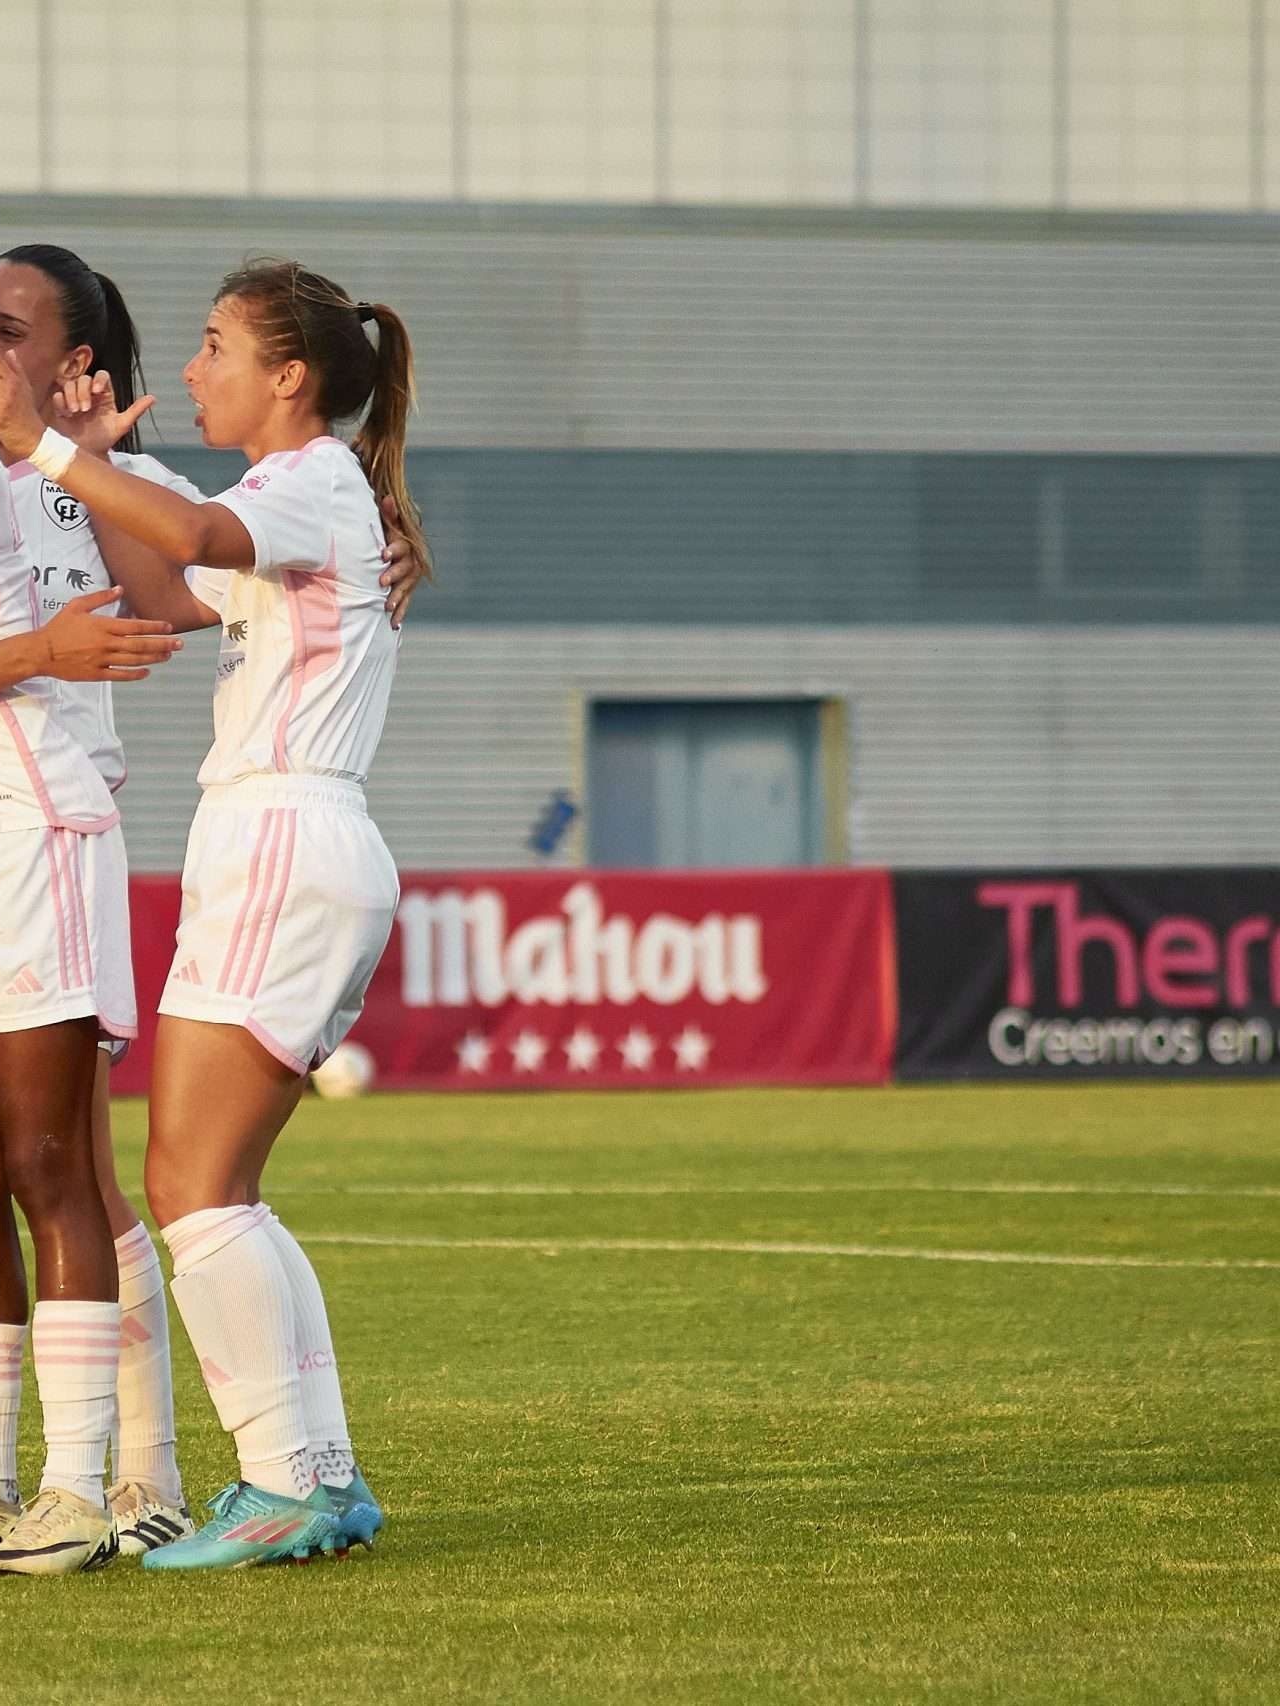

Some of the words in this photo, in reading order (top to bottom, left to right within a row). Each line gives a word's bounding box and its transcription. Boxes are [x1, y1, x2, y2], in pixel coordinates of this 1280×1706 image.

[394, 877, 769, 1007] Mahou
[976, 880, 1280, 1010] Ther
[987, 1006, 1201, 1067] Creemos
[1207, 1015, 1273, 1066] en
